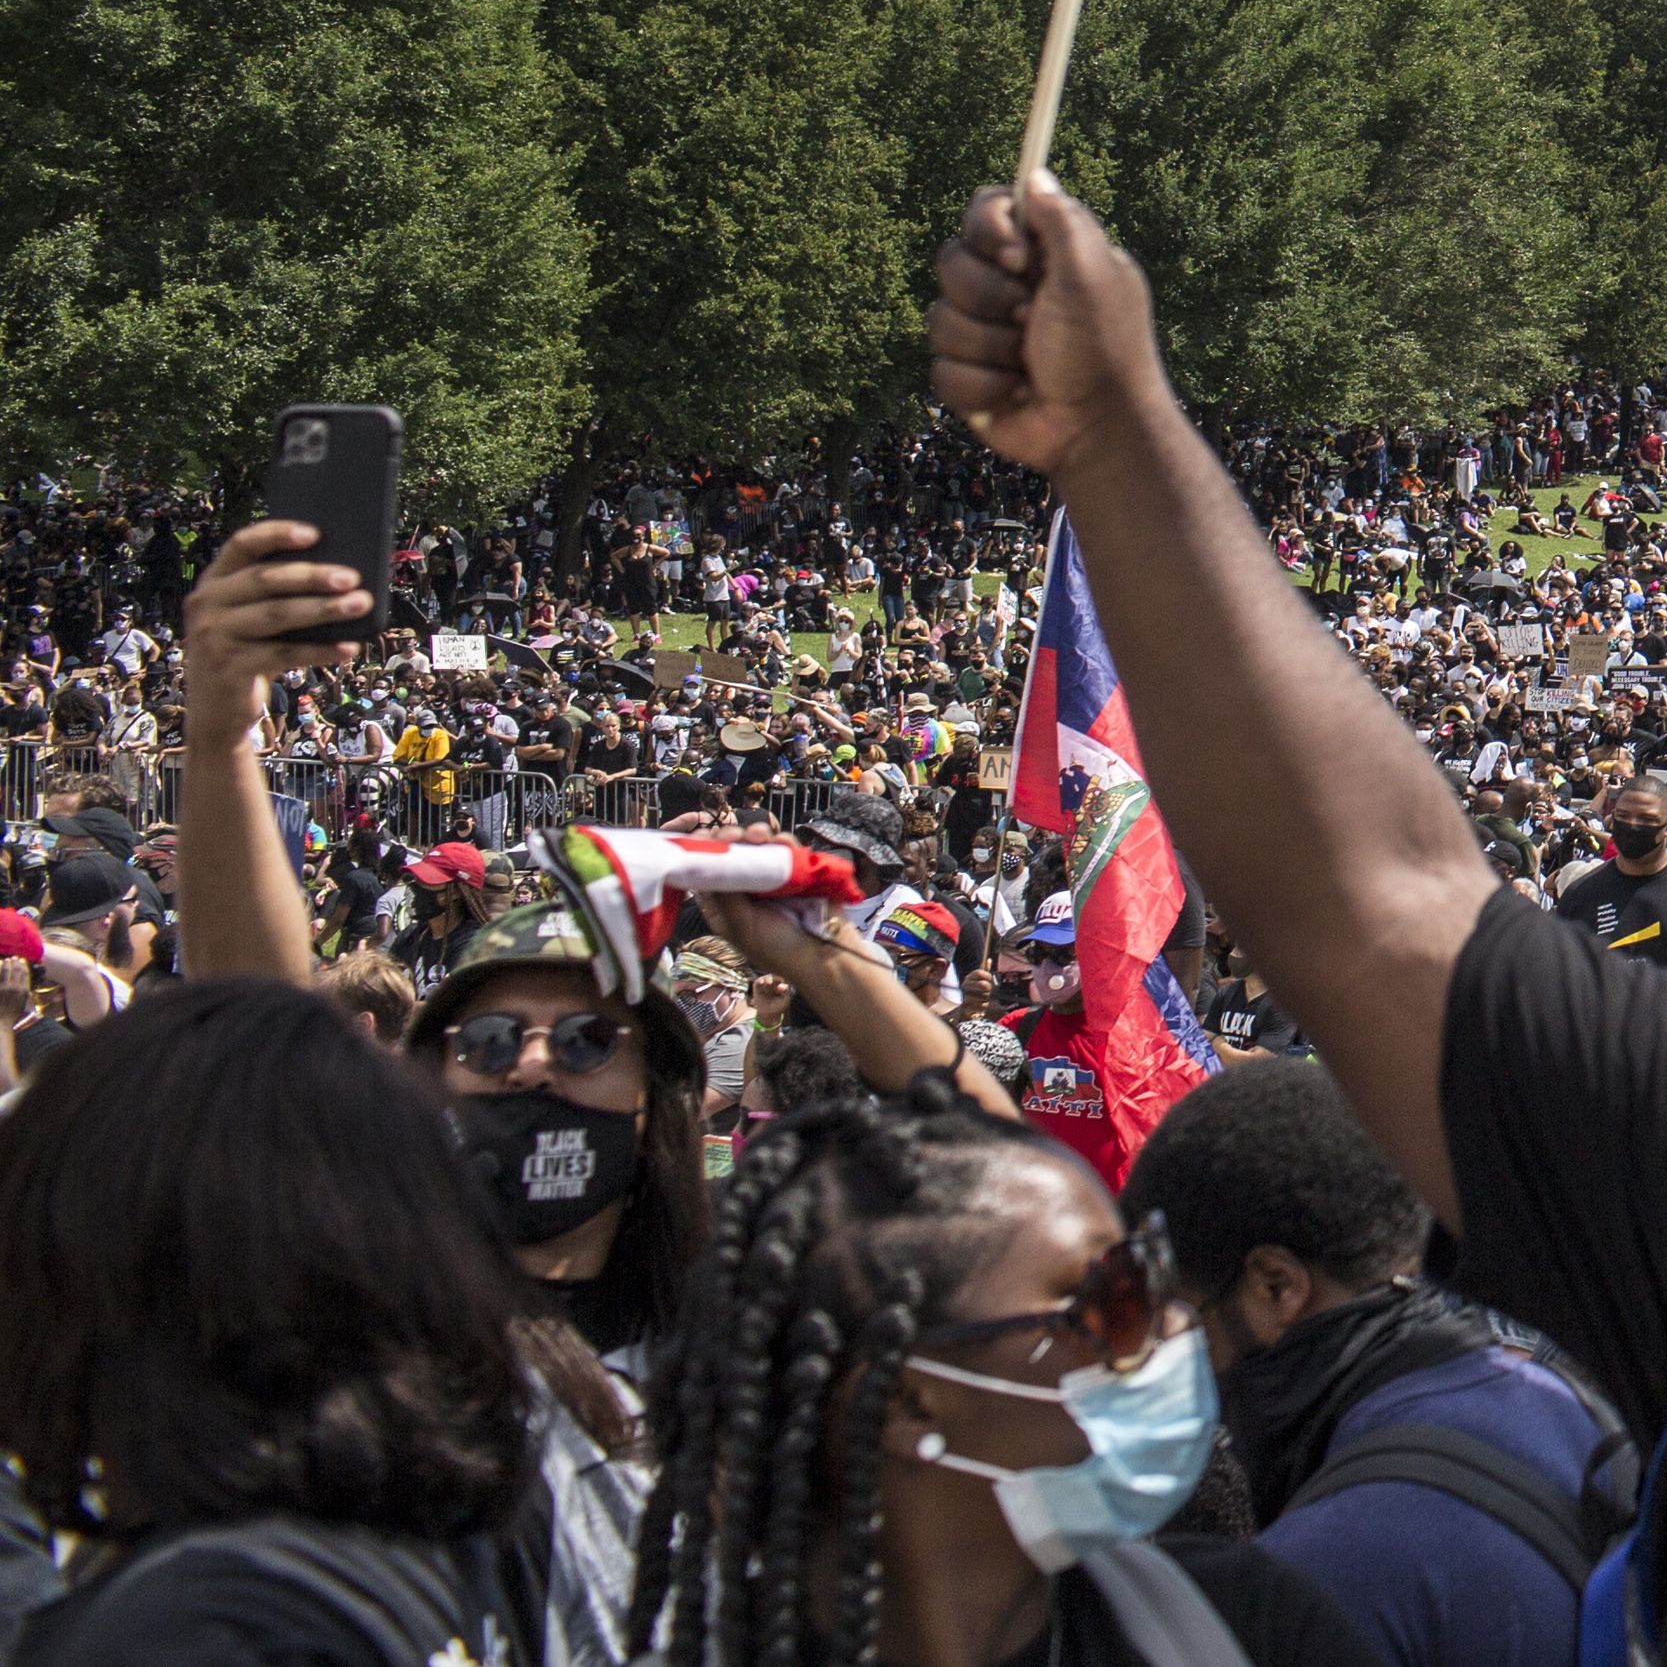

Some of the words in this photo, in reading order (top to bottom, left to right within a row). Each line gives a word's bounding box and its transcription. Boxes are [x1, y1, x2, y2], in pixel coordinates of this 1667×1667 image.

[1504, 626, 1533, 637] STOP
[1501, 635, 1539, 650] KILLING
[1530, 688, 1546, 697] STOP
[1023, 1095, 1103, 1119] AITI
[529, 1154, 589, 1179] LIVES
